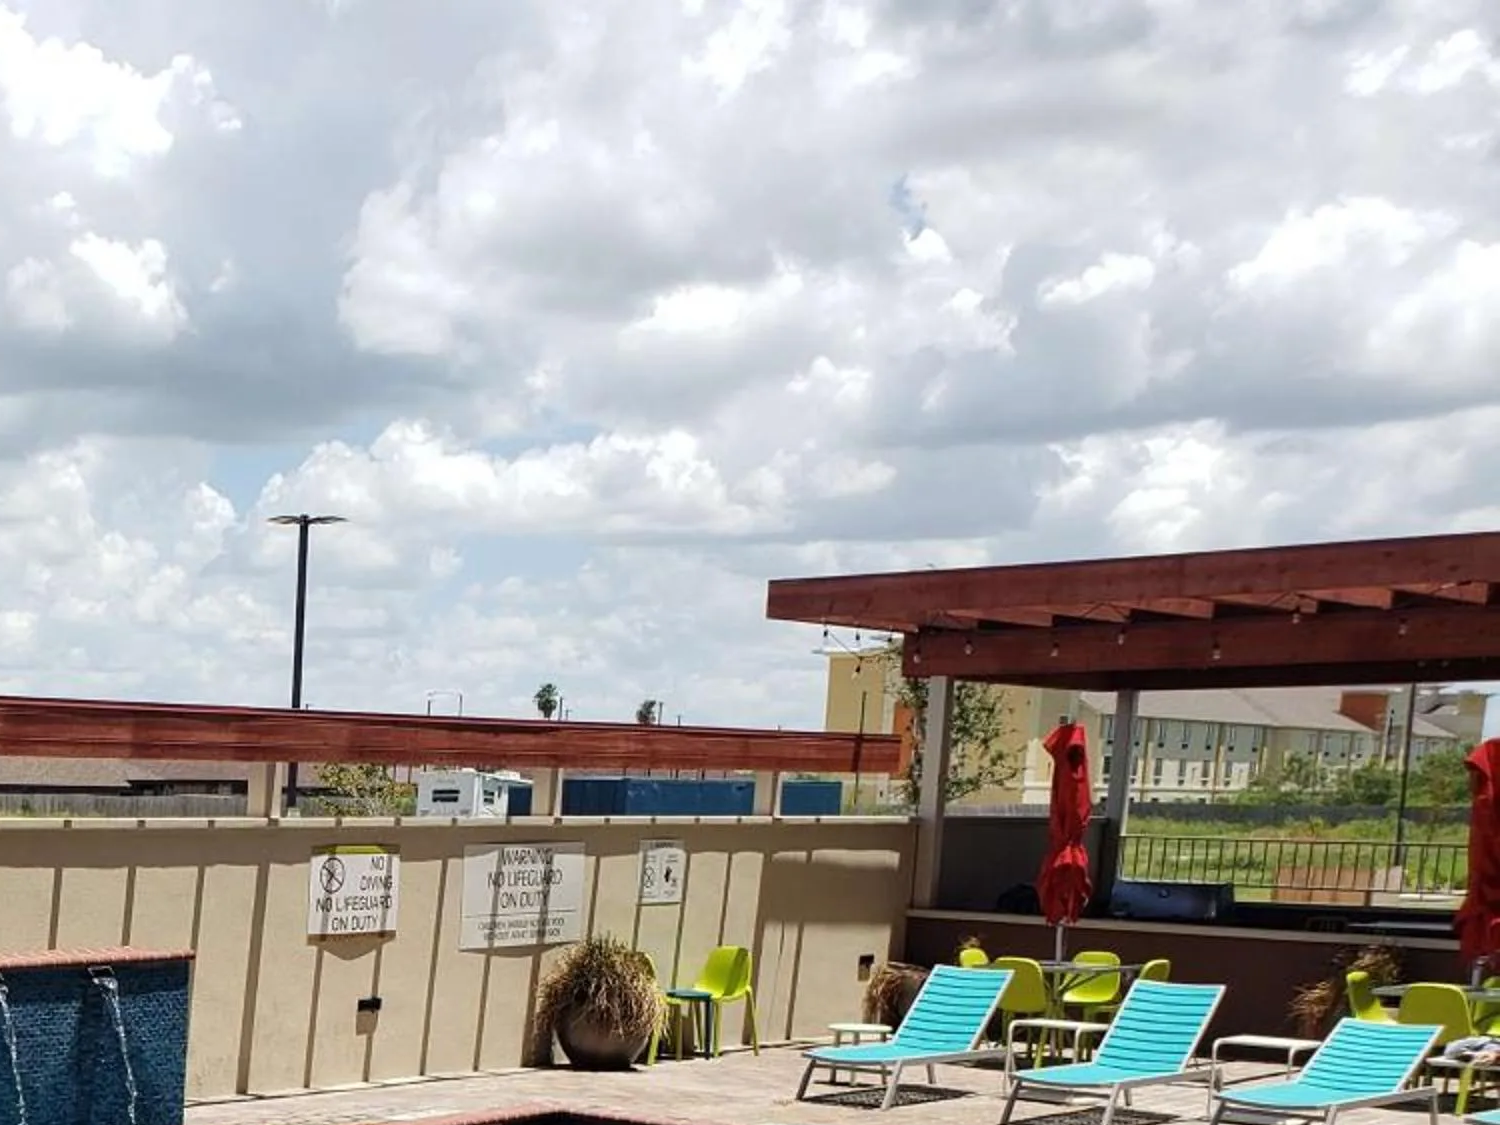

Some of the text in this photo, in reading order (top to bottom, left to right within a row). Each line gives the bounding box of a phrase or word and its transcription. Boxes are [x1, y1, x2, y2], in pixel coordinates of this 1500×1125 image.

[372, 856, 385, 870] NO
[501, 848, 552, 865] WARNING
[360, 875, 393, 890] DIVING
[488, 869, 563, 888] NO LIFEGUARD
[316, 895, 392, 912] NO LIFEGUARD
[501, 889, 550, 908] ON DUTY
[332, 913, 378, 931] ON DUTY
